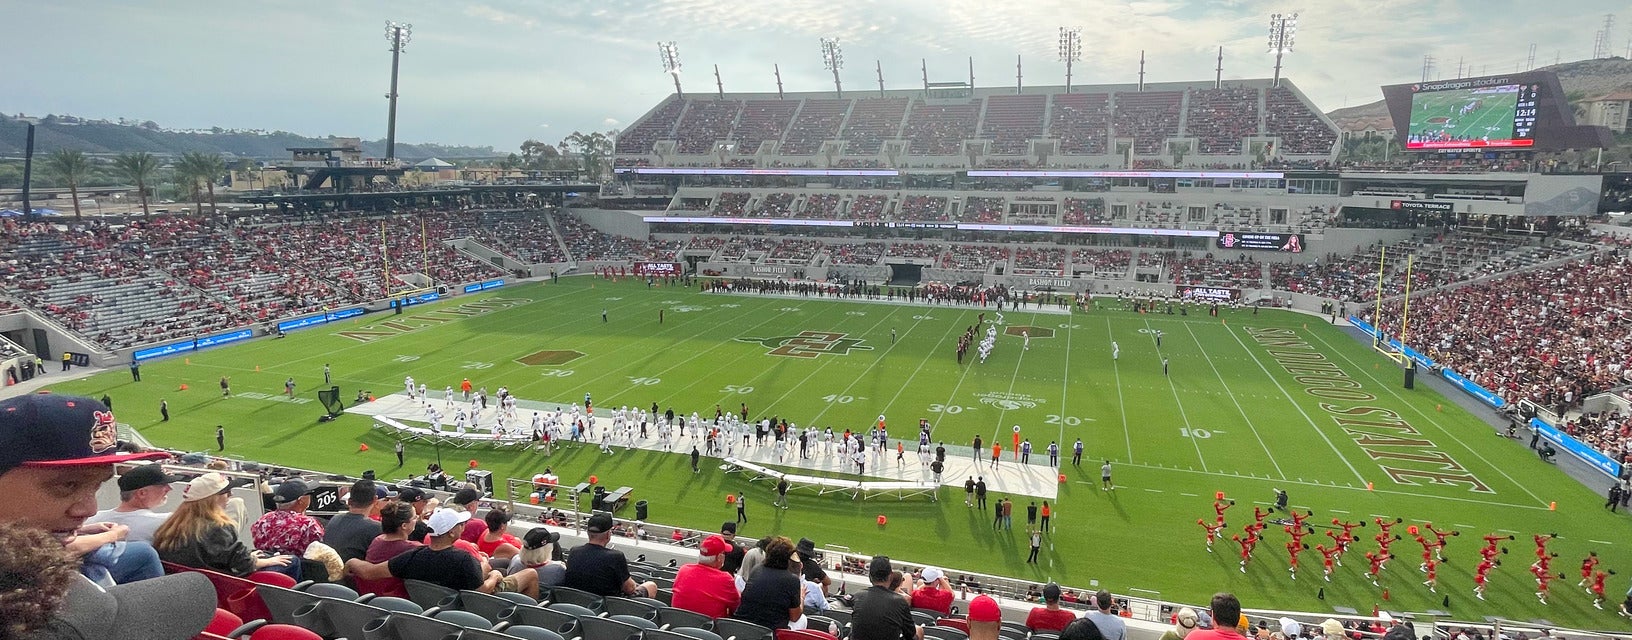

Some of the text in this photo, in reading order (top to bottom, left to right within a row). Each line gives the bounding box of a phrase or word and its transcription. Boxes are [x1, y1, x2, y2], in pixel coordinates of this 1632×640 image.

[1422, 77, 1508, 91] Snapdragon stadium
[1516, 108, 1536, 116] 12:14
[1053, 279, 1071, 287] FIELD
[460, 361, 495, 369] 20
[541, 368, 574, 377] 30
[1266, 349, 1377, 401] DIEGO
[628, 376, 661, 386] 40
[719, 384, 754, 394] 50
[821, 393, 854, 404] 40
[927, 403, 963, 414] 30
[1044, 414, 1081, 426] 20
[1179, 427, 1211, 439] 10
[1318, 402, 1497, 494] STATE
[317, 491, 337, 509] 205
